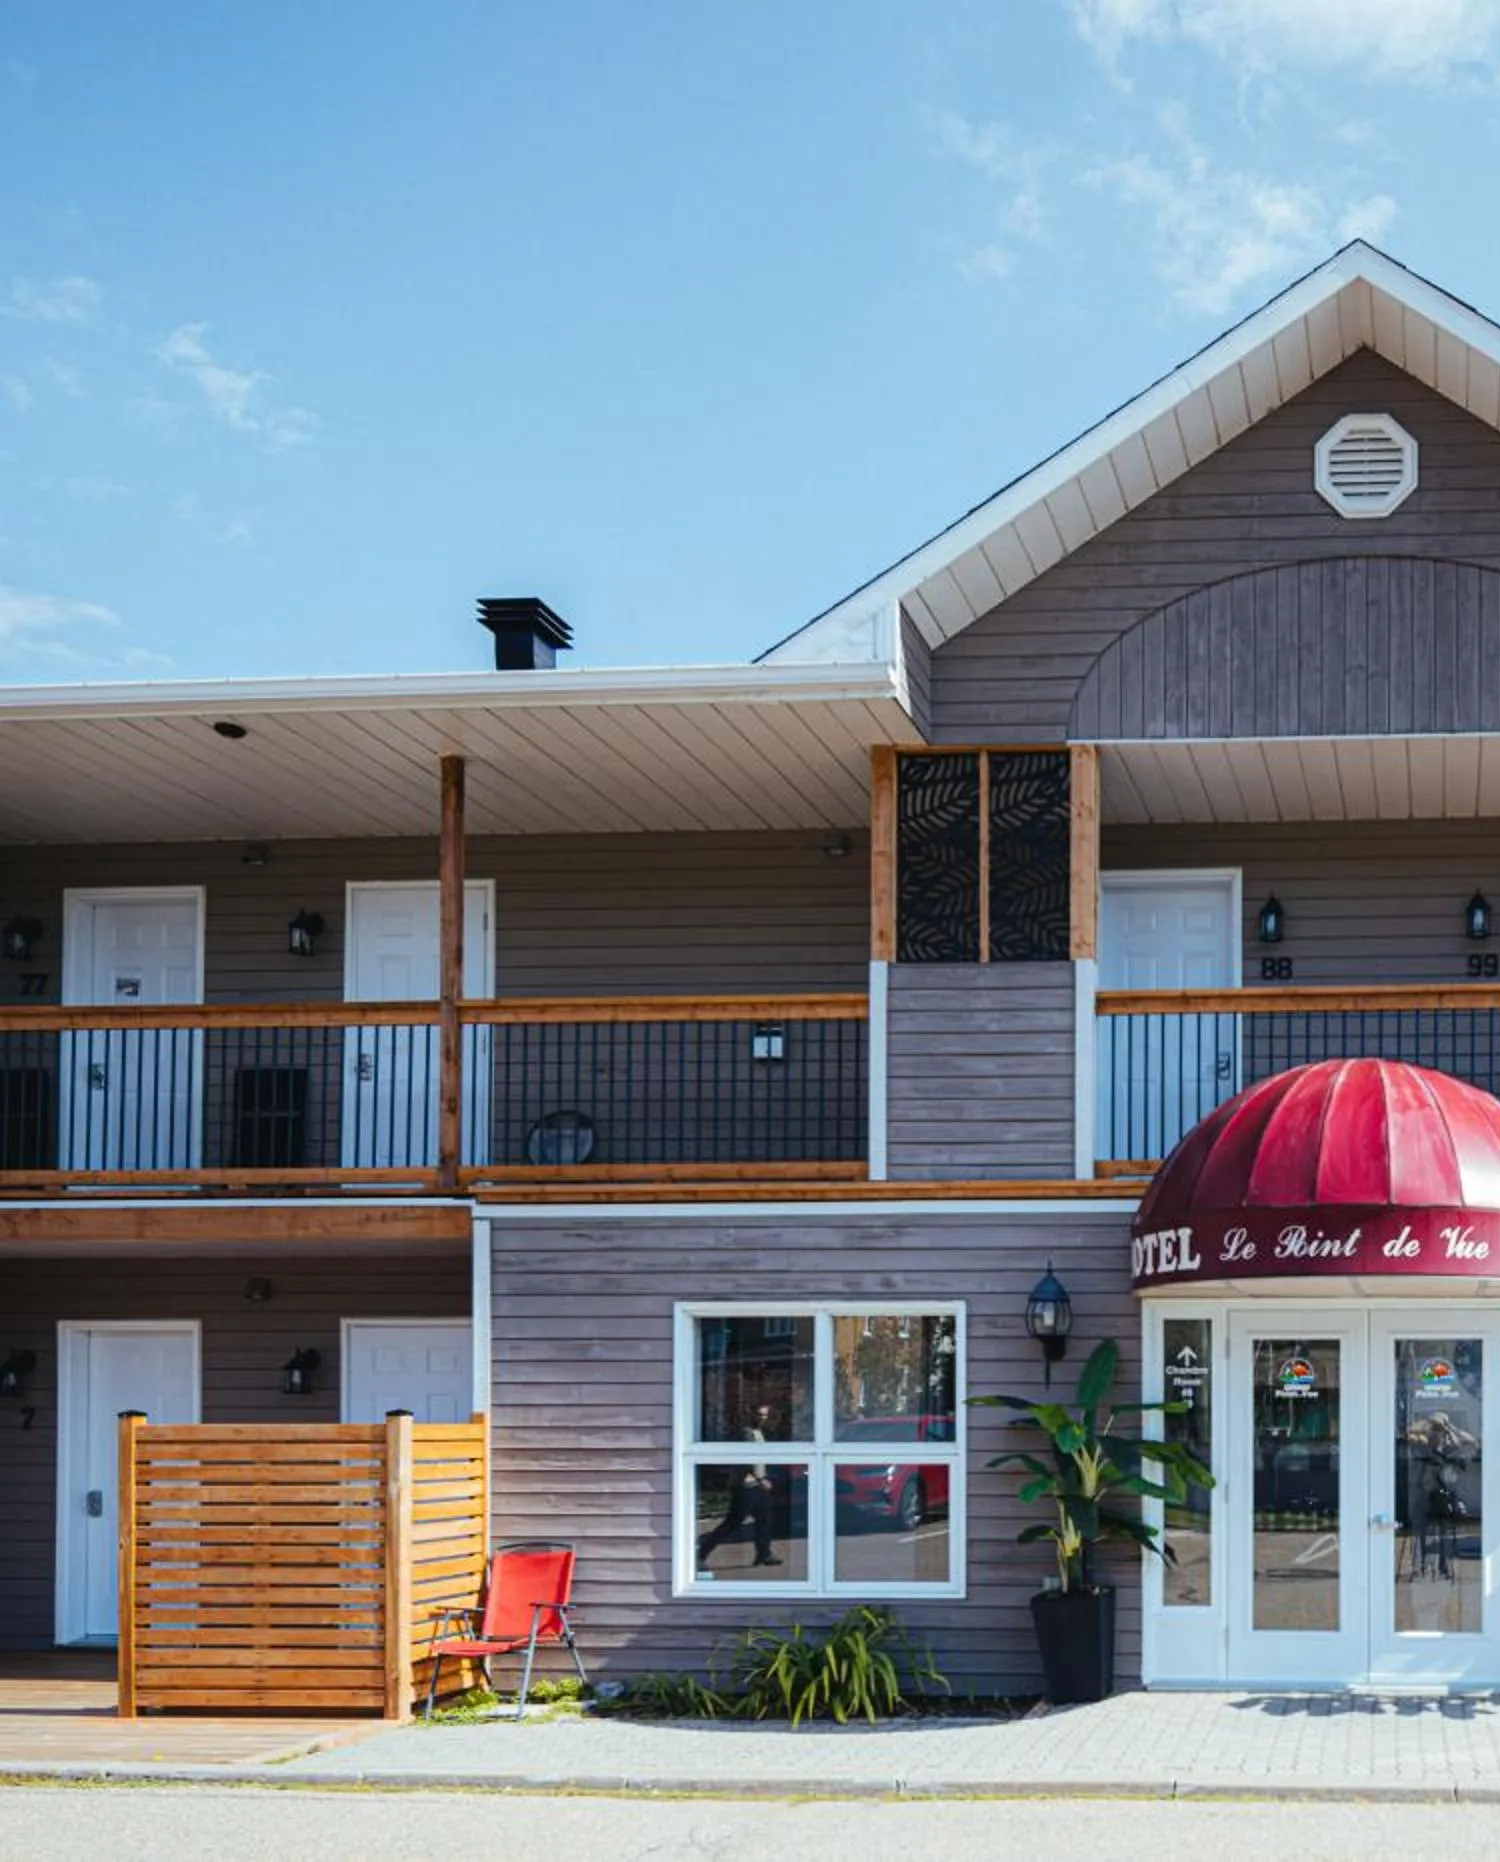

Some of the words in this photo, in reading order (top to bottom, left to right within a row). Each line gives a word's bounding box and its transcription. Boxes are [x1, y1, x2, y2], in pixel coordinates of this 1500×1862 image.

[1261, 957, 1293, 980] 88
[1468, 953, 1498, 977] 99
[20, 974, 48, 996] 77
[1219, 1227, 1257, 1261] Le
[1274, 1225, 1361, 1258] Point
[1382, 1225, 1421, 1257] de
[1439, 1225, 1489, 1259] Vue
[21, 1407, 35, 1430] 7
